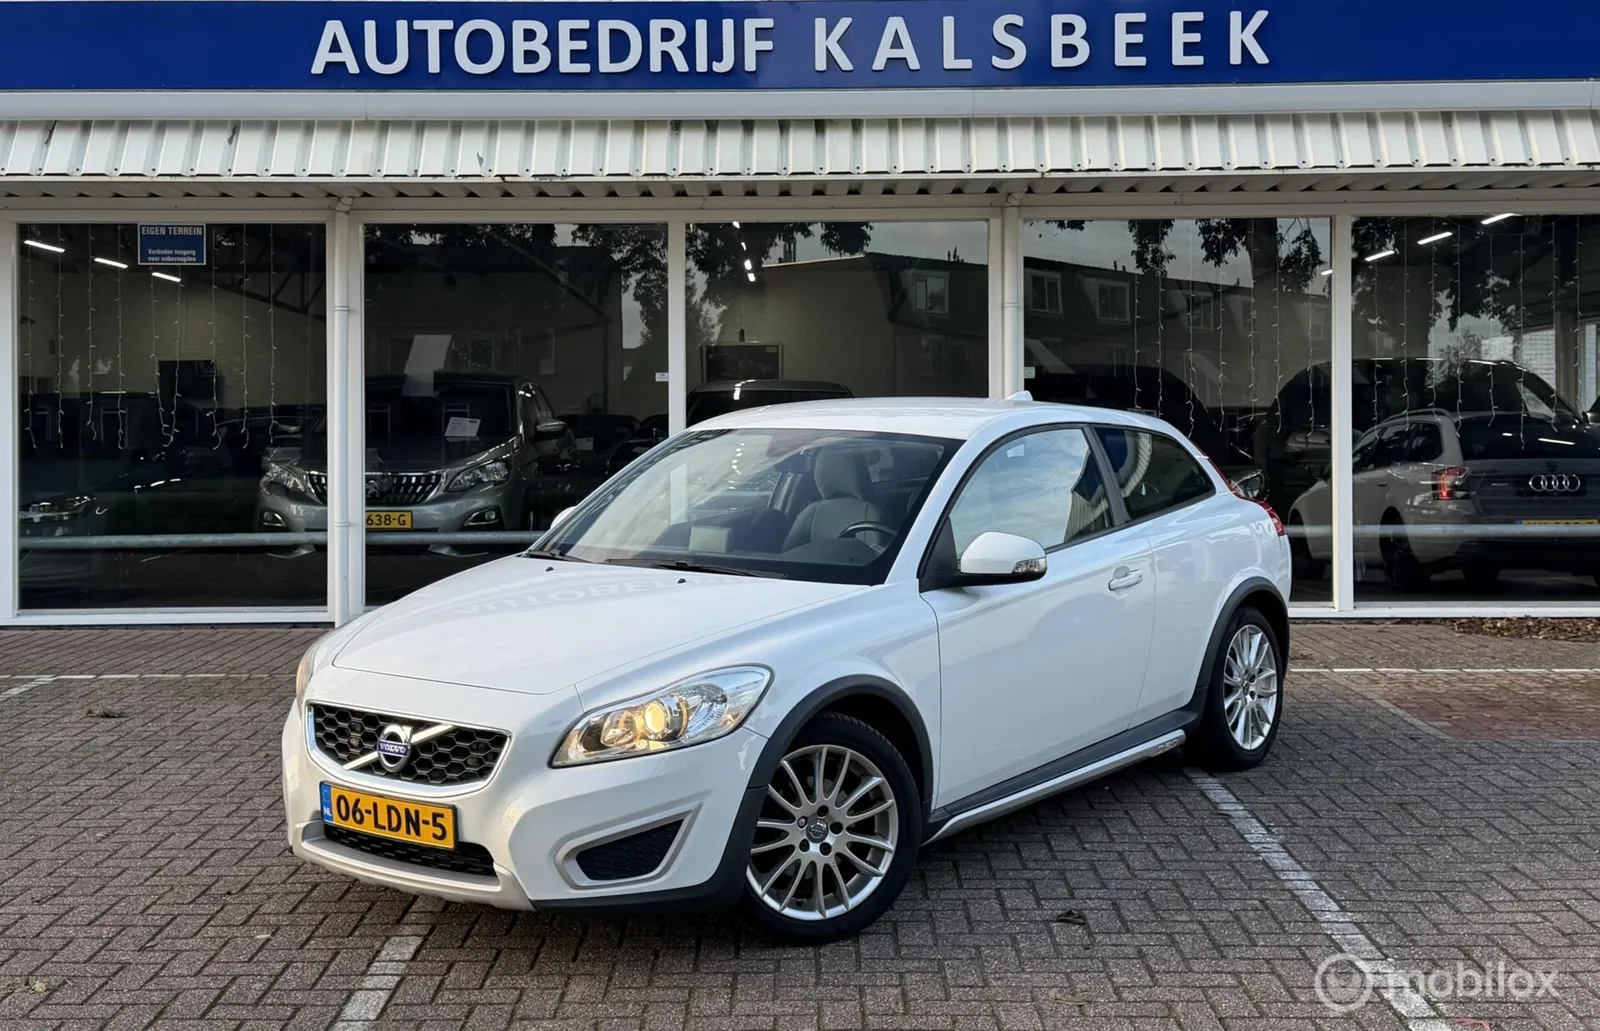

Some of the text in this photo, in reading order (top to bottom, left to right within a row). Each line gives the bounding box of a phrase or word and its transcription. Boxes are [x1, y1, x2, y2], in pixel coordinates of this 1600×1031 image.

[311, 10, 1270, 75] AUTOBEDRIJF KALSBEEK
[141, 226, 202, 236] EIGEN TERREIN
[366, 513, 406, 526] 638-G
[379, 742, 407, 754] VOLVO
[323, 806, 333, 817] NL
[336, 794, 447, 841] 06-LDN-5
